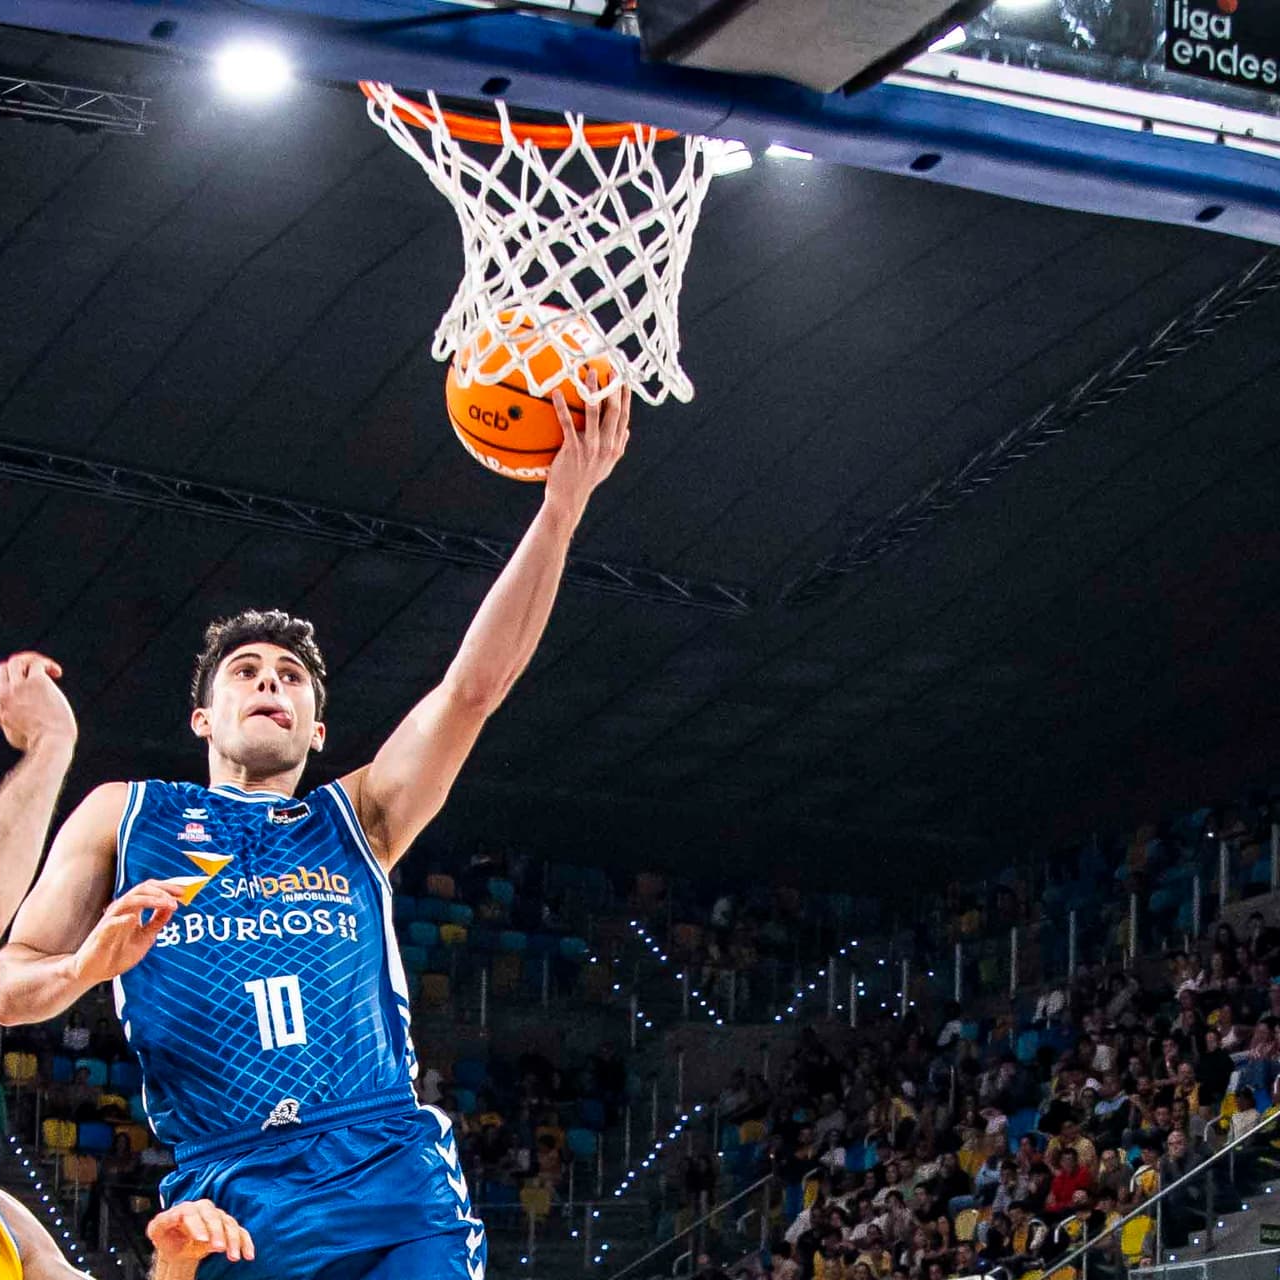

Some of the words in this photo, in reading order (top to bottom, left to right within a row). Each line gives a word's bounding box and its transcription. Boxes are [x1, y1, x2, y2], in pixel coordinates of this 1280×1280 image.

[1173, 0, 1232, 40] liga
[469, 404, 509, 431] acb
[259, 866, 350, 898] pablo
[282, 893, 352, 905] INMOBILIARIA
[184, 909, 334, 945] BURGOS
[245, 975, 307, 1051] 10
